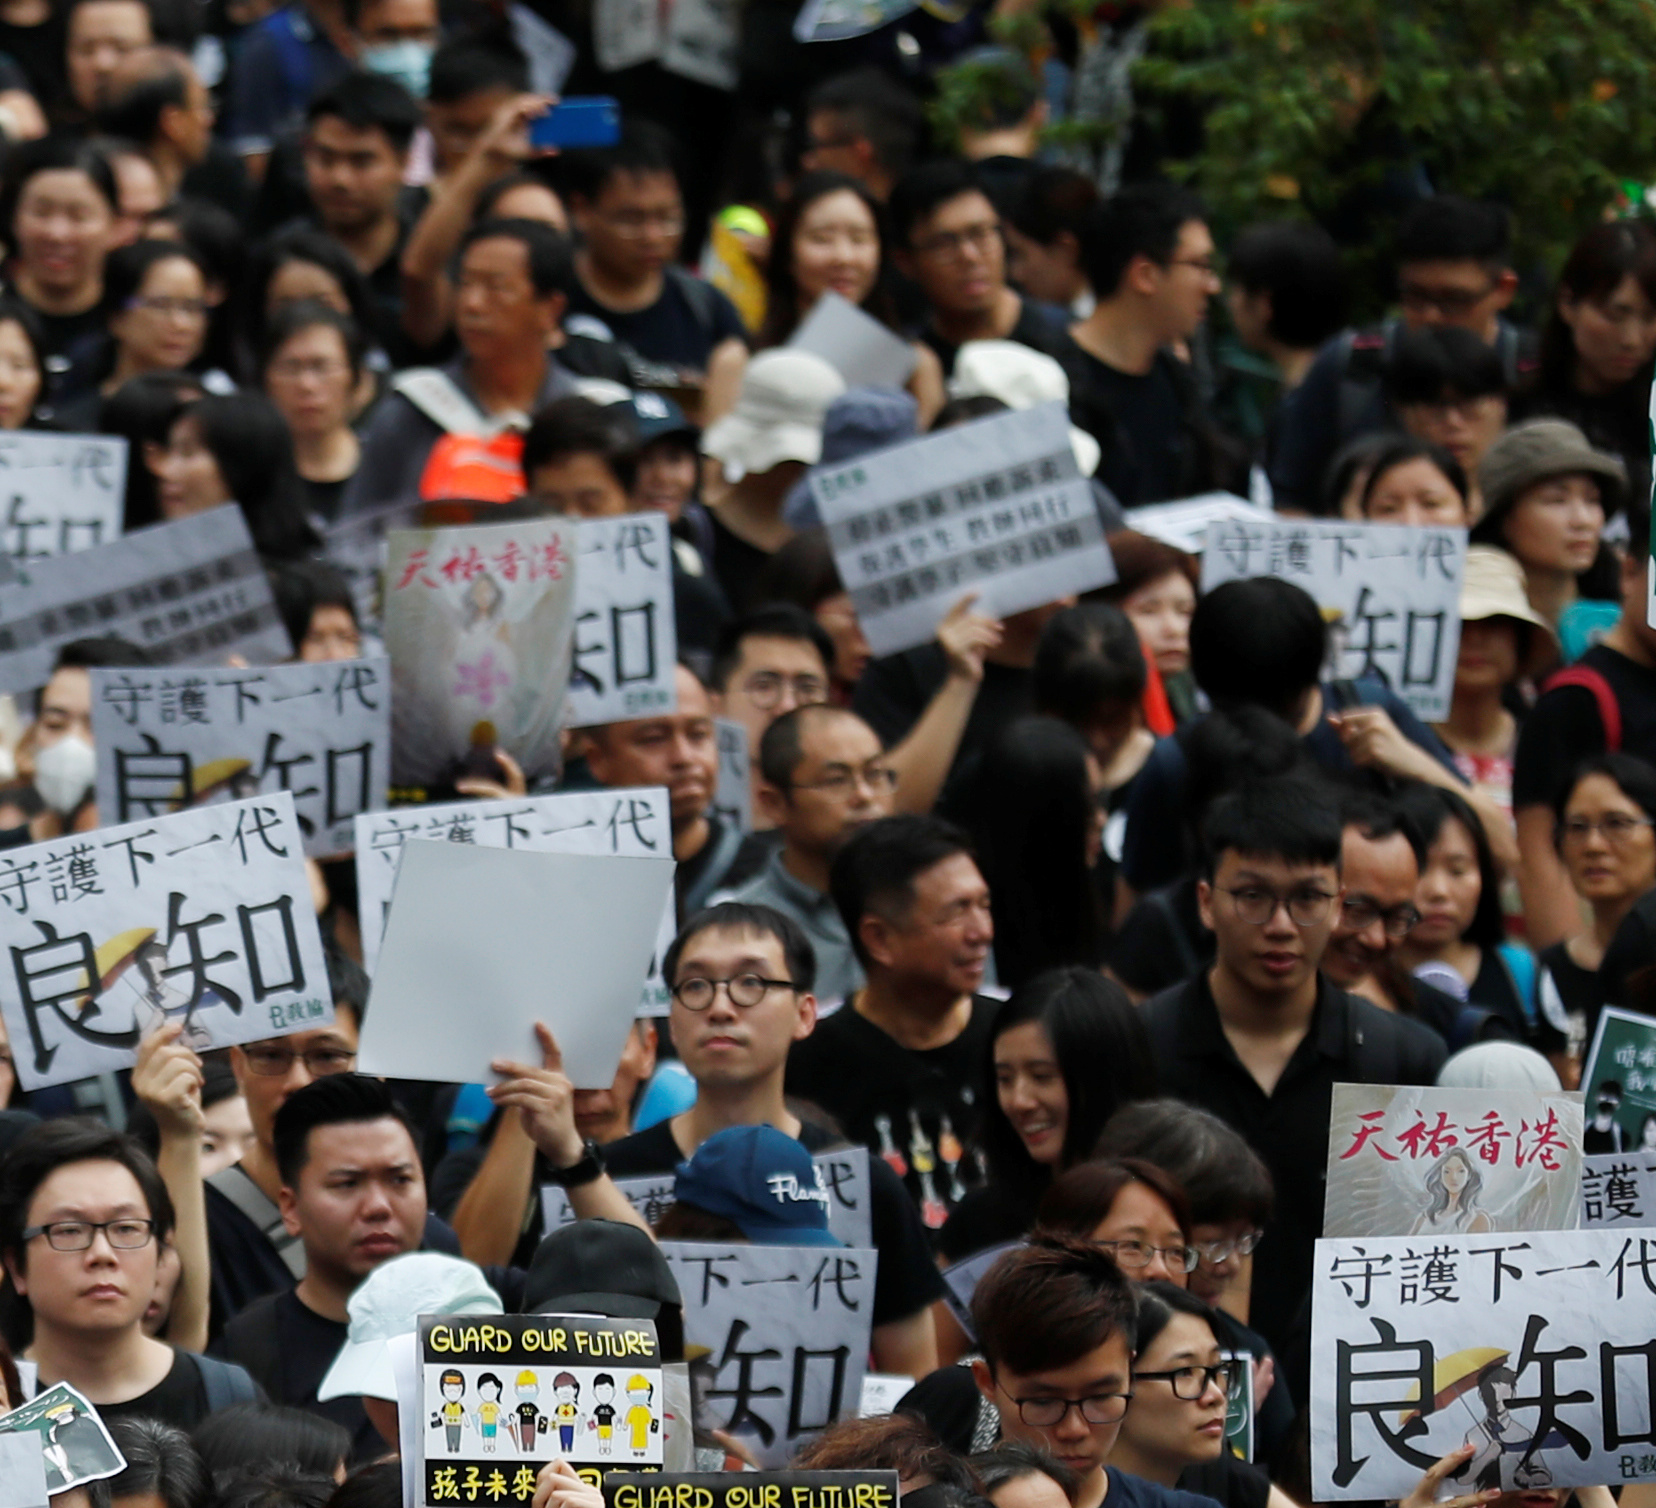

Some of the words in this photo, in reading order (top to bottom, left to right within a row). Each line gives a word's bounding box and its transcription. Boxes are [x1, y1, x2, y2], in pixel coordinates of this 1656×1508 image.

[102, 665, 382, 728] 守護下一代
[8, 889, 307, 1077] 良知
[1339, 1109, 1569, 1172] 天祐香港
[428, 1323, 513, 1352] GUARD
[520, 1326, 571, 1354] OUR
[573, 1329, 657, 1358] FUTURE
[702, 1319, 850, 1450] 知
[1333, 1314, 1656, 1490] 良知
